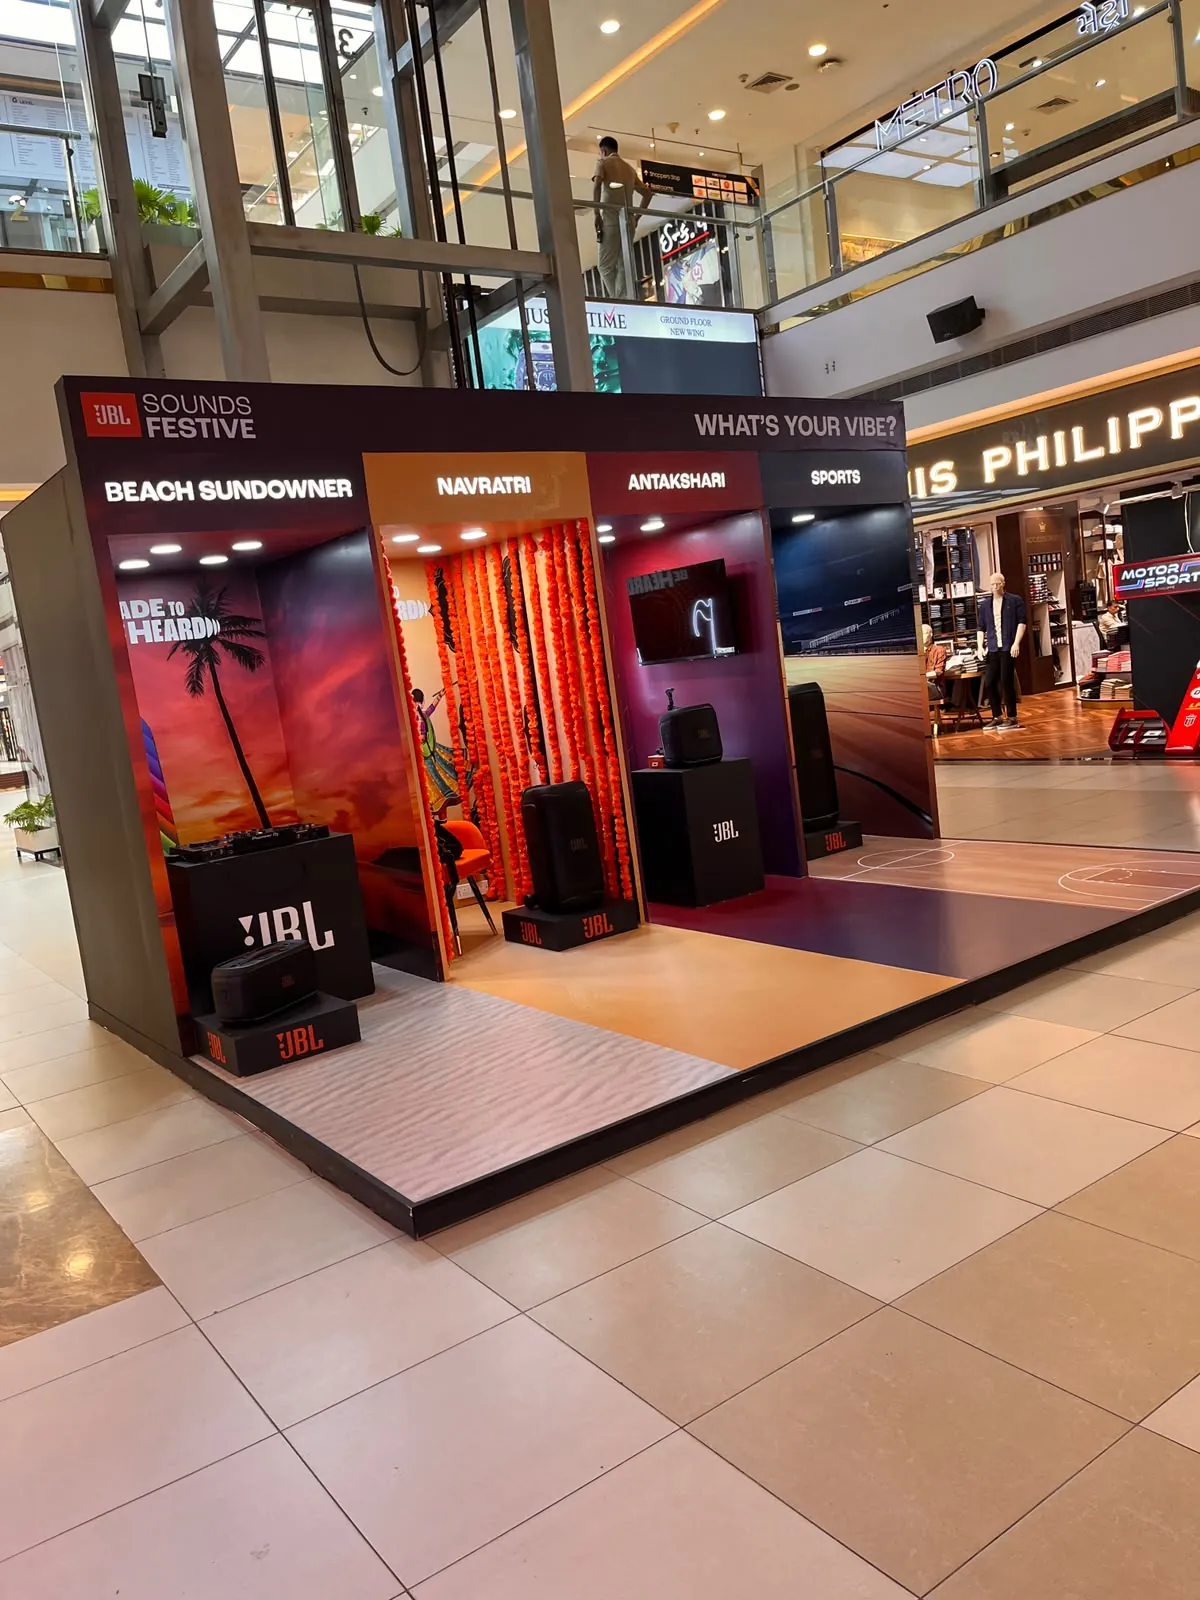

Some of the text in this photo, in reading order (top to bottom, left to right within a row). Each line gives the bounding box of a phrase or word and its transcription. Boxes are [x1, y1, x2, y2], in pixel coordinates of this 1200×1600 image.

[875, 58, 998, 151] METRO
[525, 307, 627, 330] JUS TIME
[660, 315, 712, 327] GROUND FLOOR
[670, 327, 705, 338] NEW WING
[94, 404, 131, 425] JBL
[142, 393, 252, 415] SOUNDS
[145, 417, 257, 439] FESTIVE
[694, 414, 897, 437] WHAT'S YOUR VIBE?
[436, 475, 531, 496] NAVRATRI
[628, 472, 726, 491] ANTAKSHARI
[811, 469, 861, 486] SPORTS
[104, 478, 353, 502] BEACH SUNDOWNER
[1121, 563, 1180, 580] MOTOR
[119, 598, 185, 620] ADE TO
[127, 616, 207, 645] HEARD
[712, 819, 739, 843] JBL
[825, 832, 847, 851] JBL
[520, 921, 542, 945] JBL
[582, 913, 614, 938] JBL
[207, 1032, 226, 1064] JBL
[276, 1025, 324, 1060] JBL
